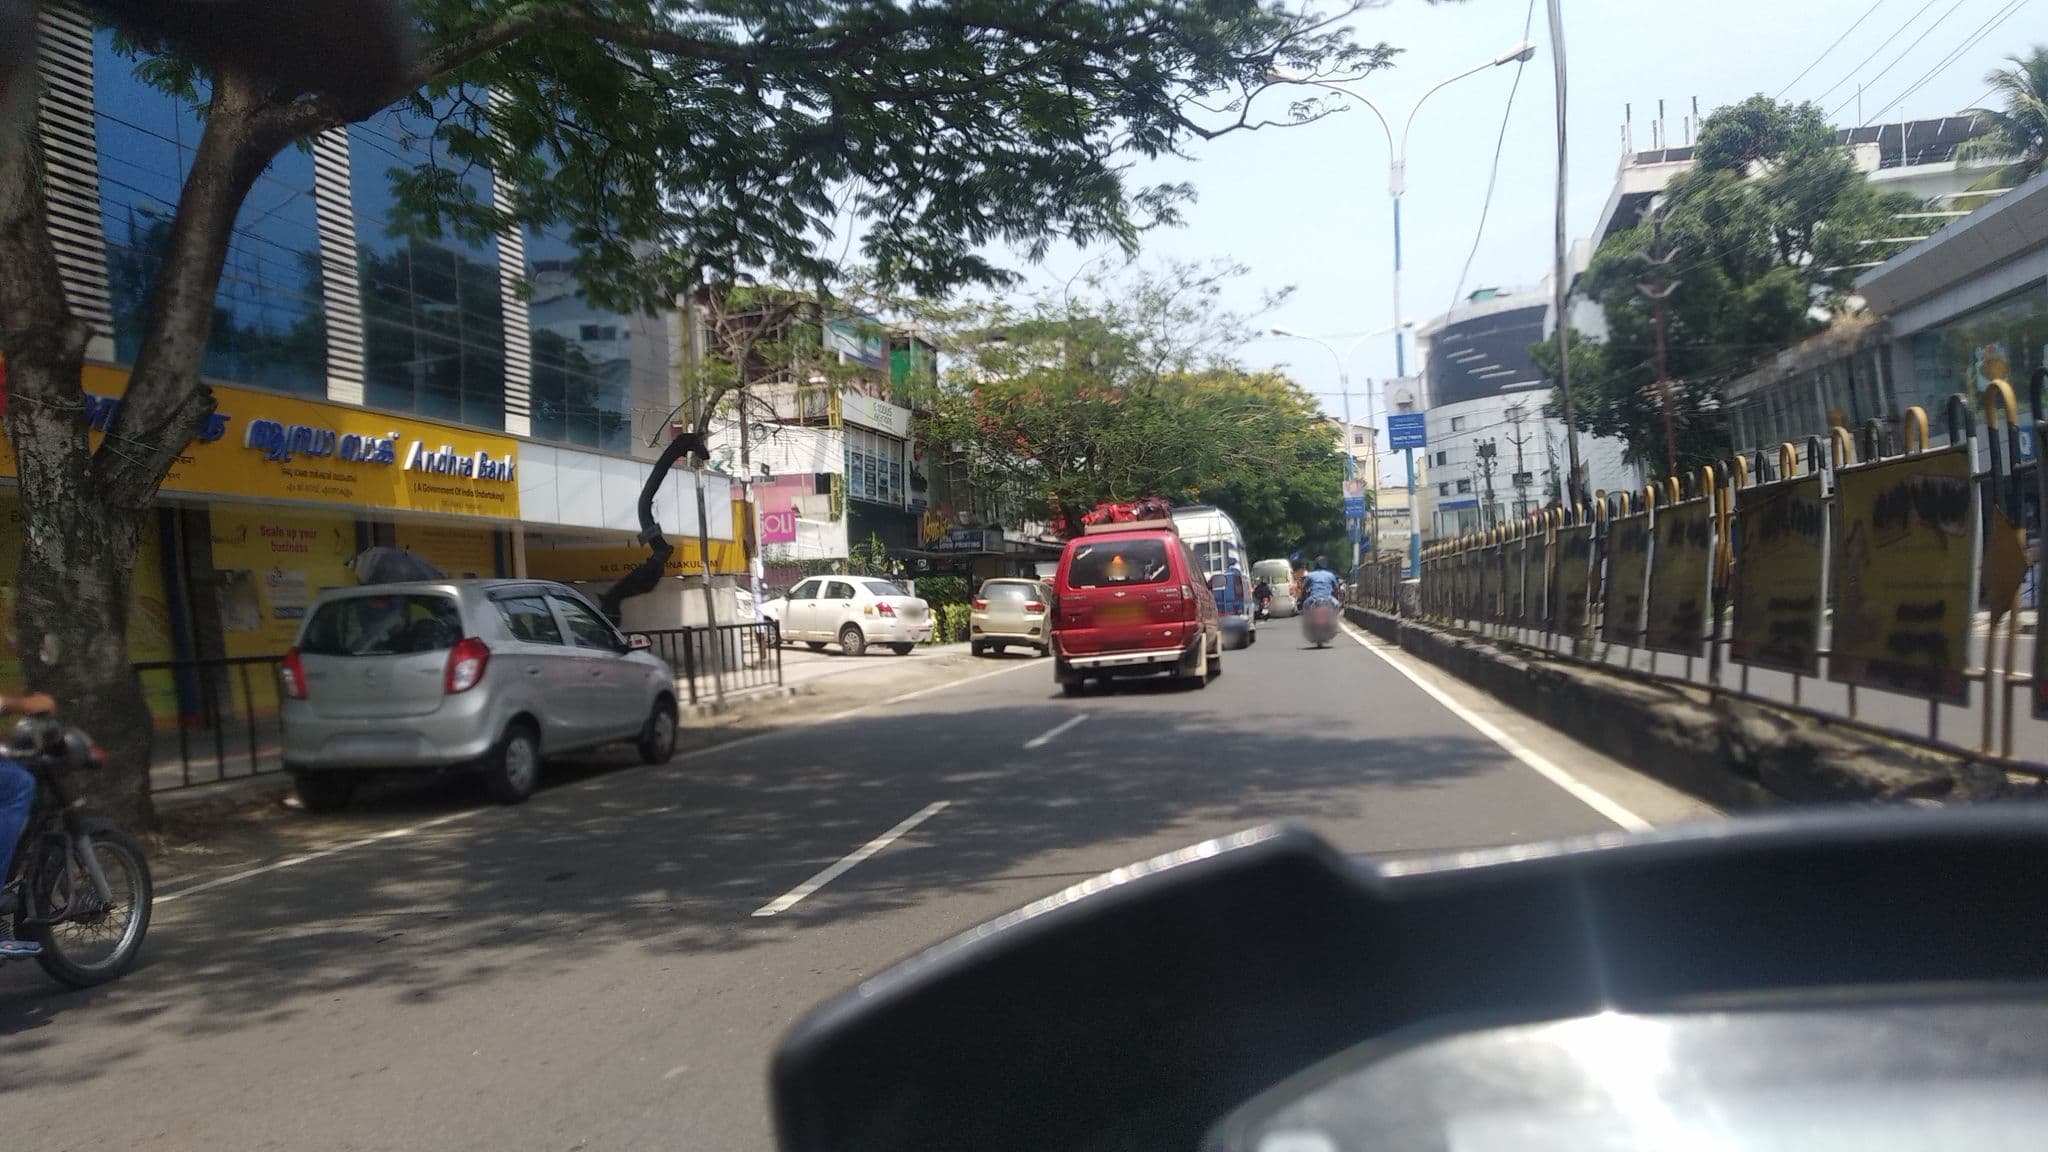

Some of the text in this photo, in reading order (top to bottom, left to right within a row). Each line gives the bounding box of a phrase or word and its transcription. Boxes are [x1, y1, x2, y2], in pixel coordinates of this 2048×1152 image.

[404, 441, 516, 482] Andhra Bank
[423, 483, 454, 495] Government
[260, 525, 316, 540] Scale up your
[271, 541, 309, 553] business
